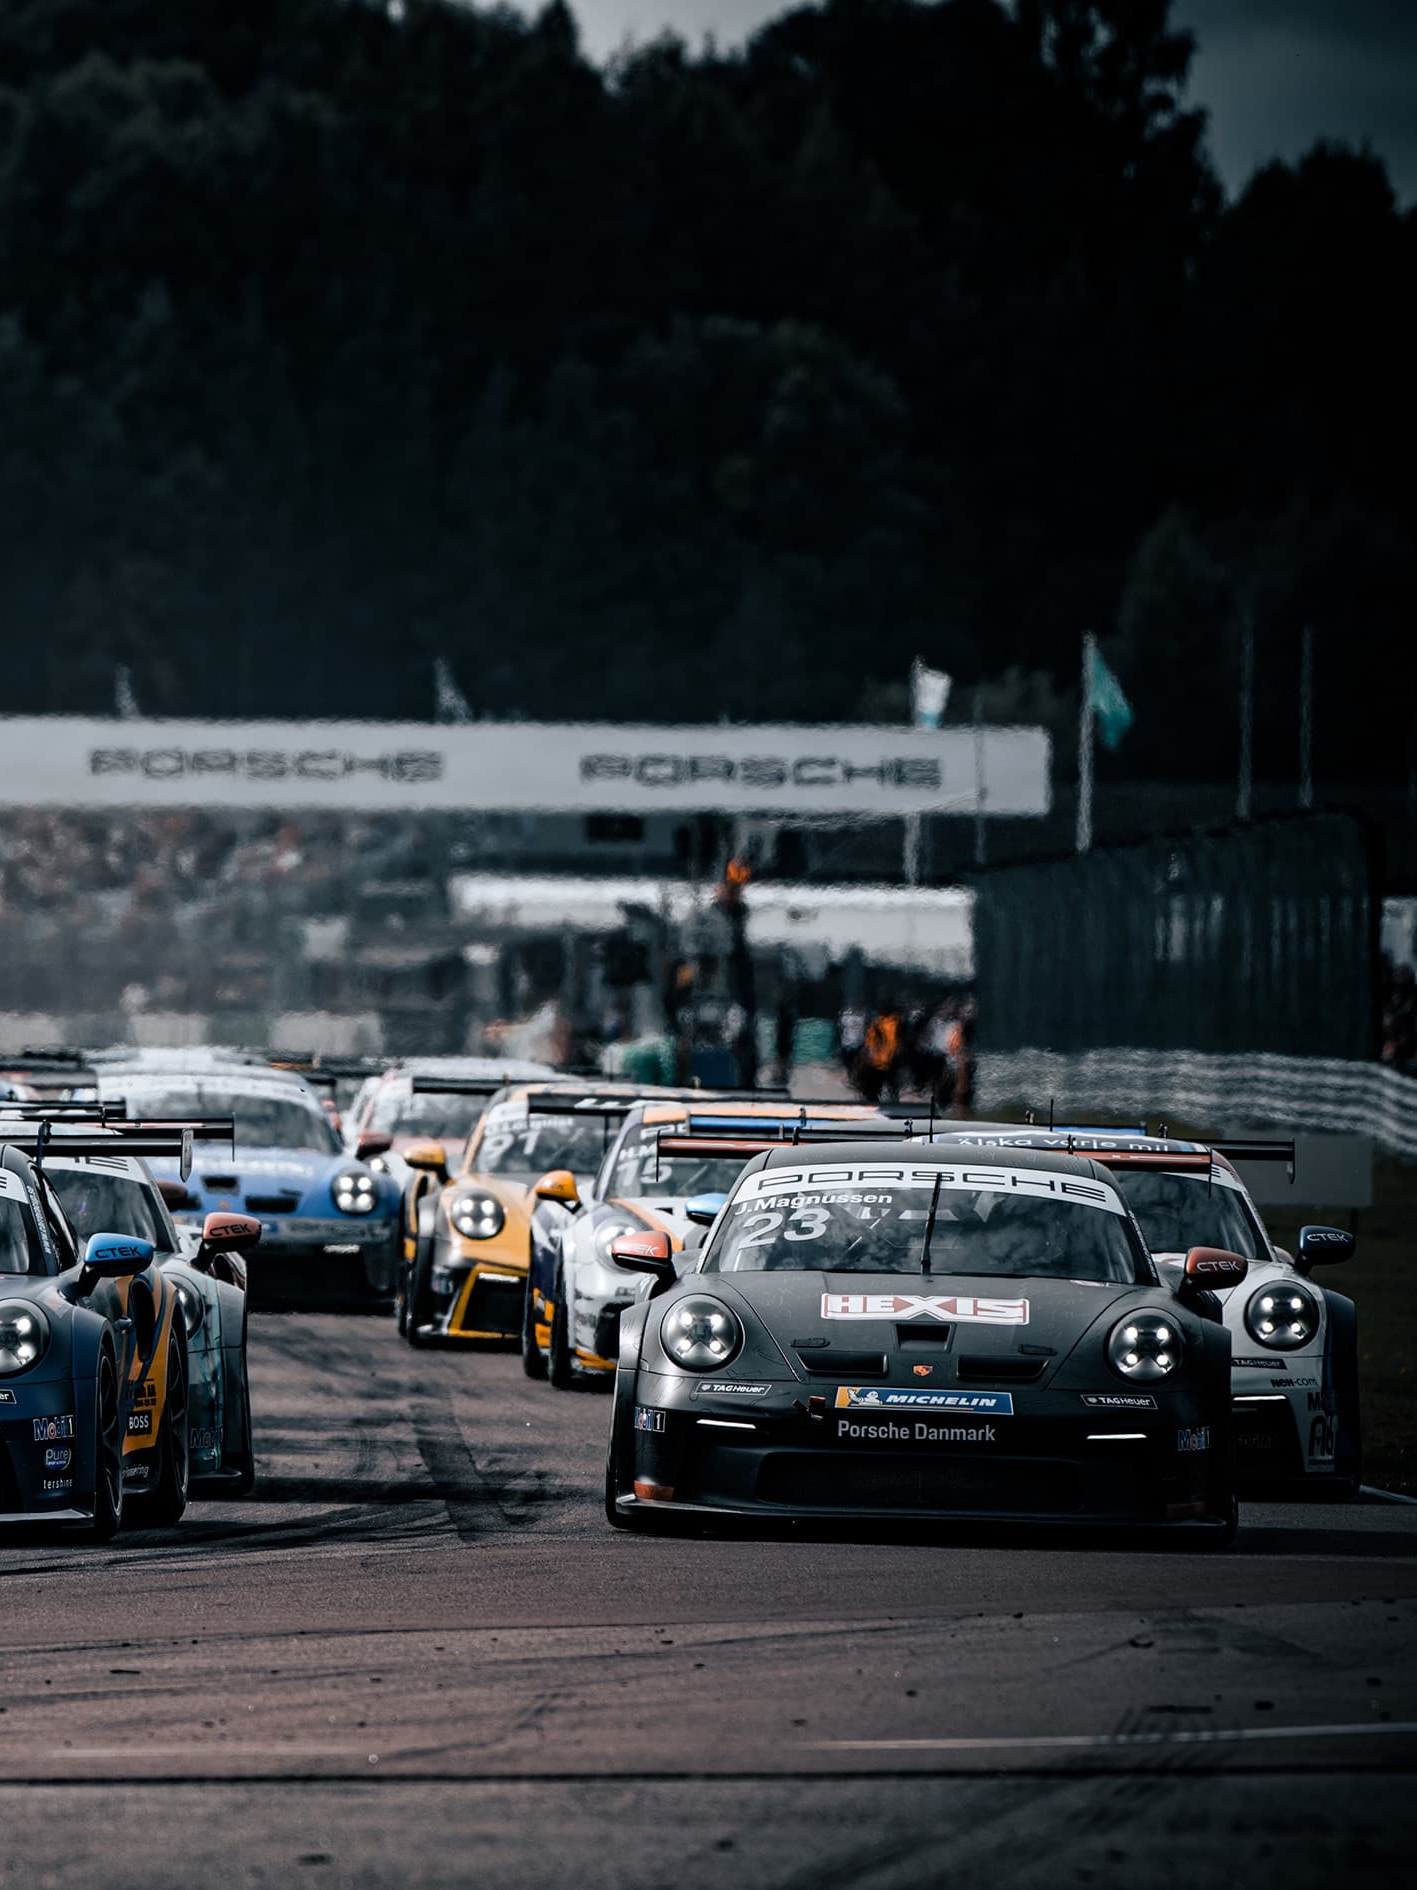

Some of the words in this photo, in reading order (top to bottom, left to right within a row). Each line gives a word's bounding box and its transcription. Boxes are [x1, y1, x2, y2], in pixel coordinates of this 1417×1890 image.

[89, 747, 442, 783] PORSCHE
[579, 753, 942, 788] PORSCHE
[1129, 1141, 1169, 1152] mil
[617, 1156, 672, 1186] 15
[758, 1170, 1106, 1203] PORSCHE
[734, 1193, 892, 1216] J.Magnussen
[209, 1223, 253, 1238] CTEK
[739, 1206, 831, 1250] 23
[1306, 1231, 1349, 1243] CTEK
[94, 1246, 139, 1260] CTEK
[1196, 1259, 1242, 1272] CTEK
[826, 1295, 1024, 1320] HEXIS
[886, 1394, 997, 1407] MICHELIN
[32, 1416, 67, 1441] Mobil
[128, 1415, 150, 1430] BOSS
[838, 1420, 911, 1440] Porsche
[915, 1423, 996, 1441] Danmark
